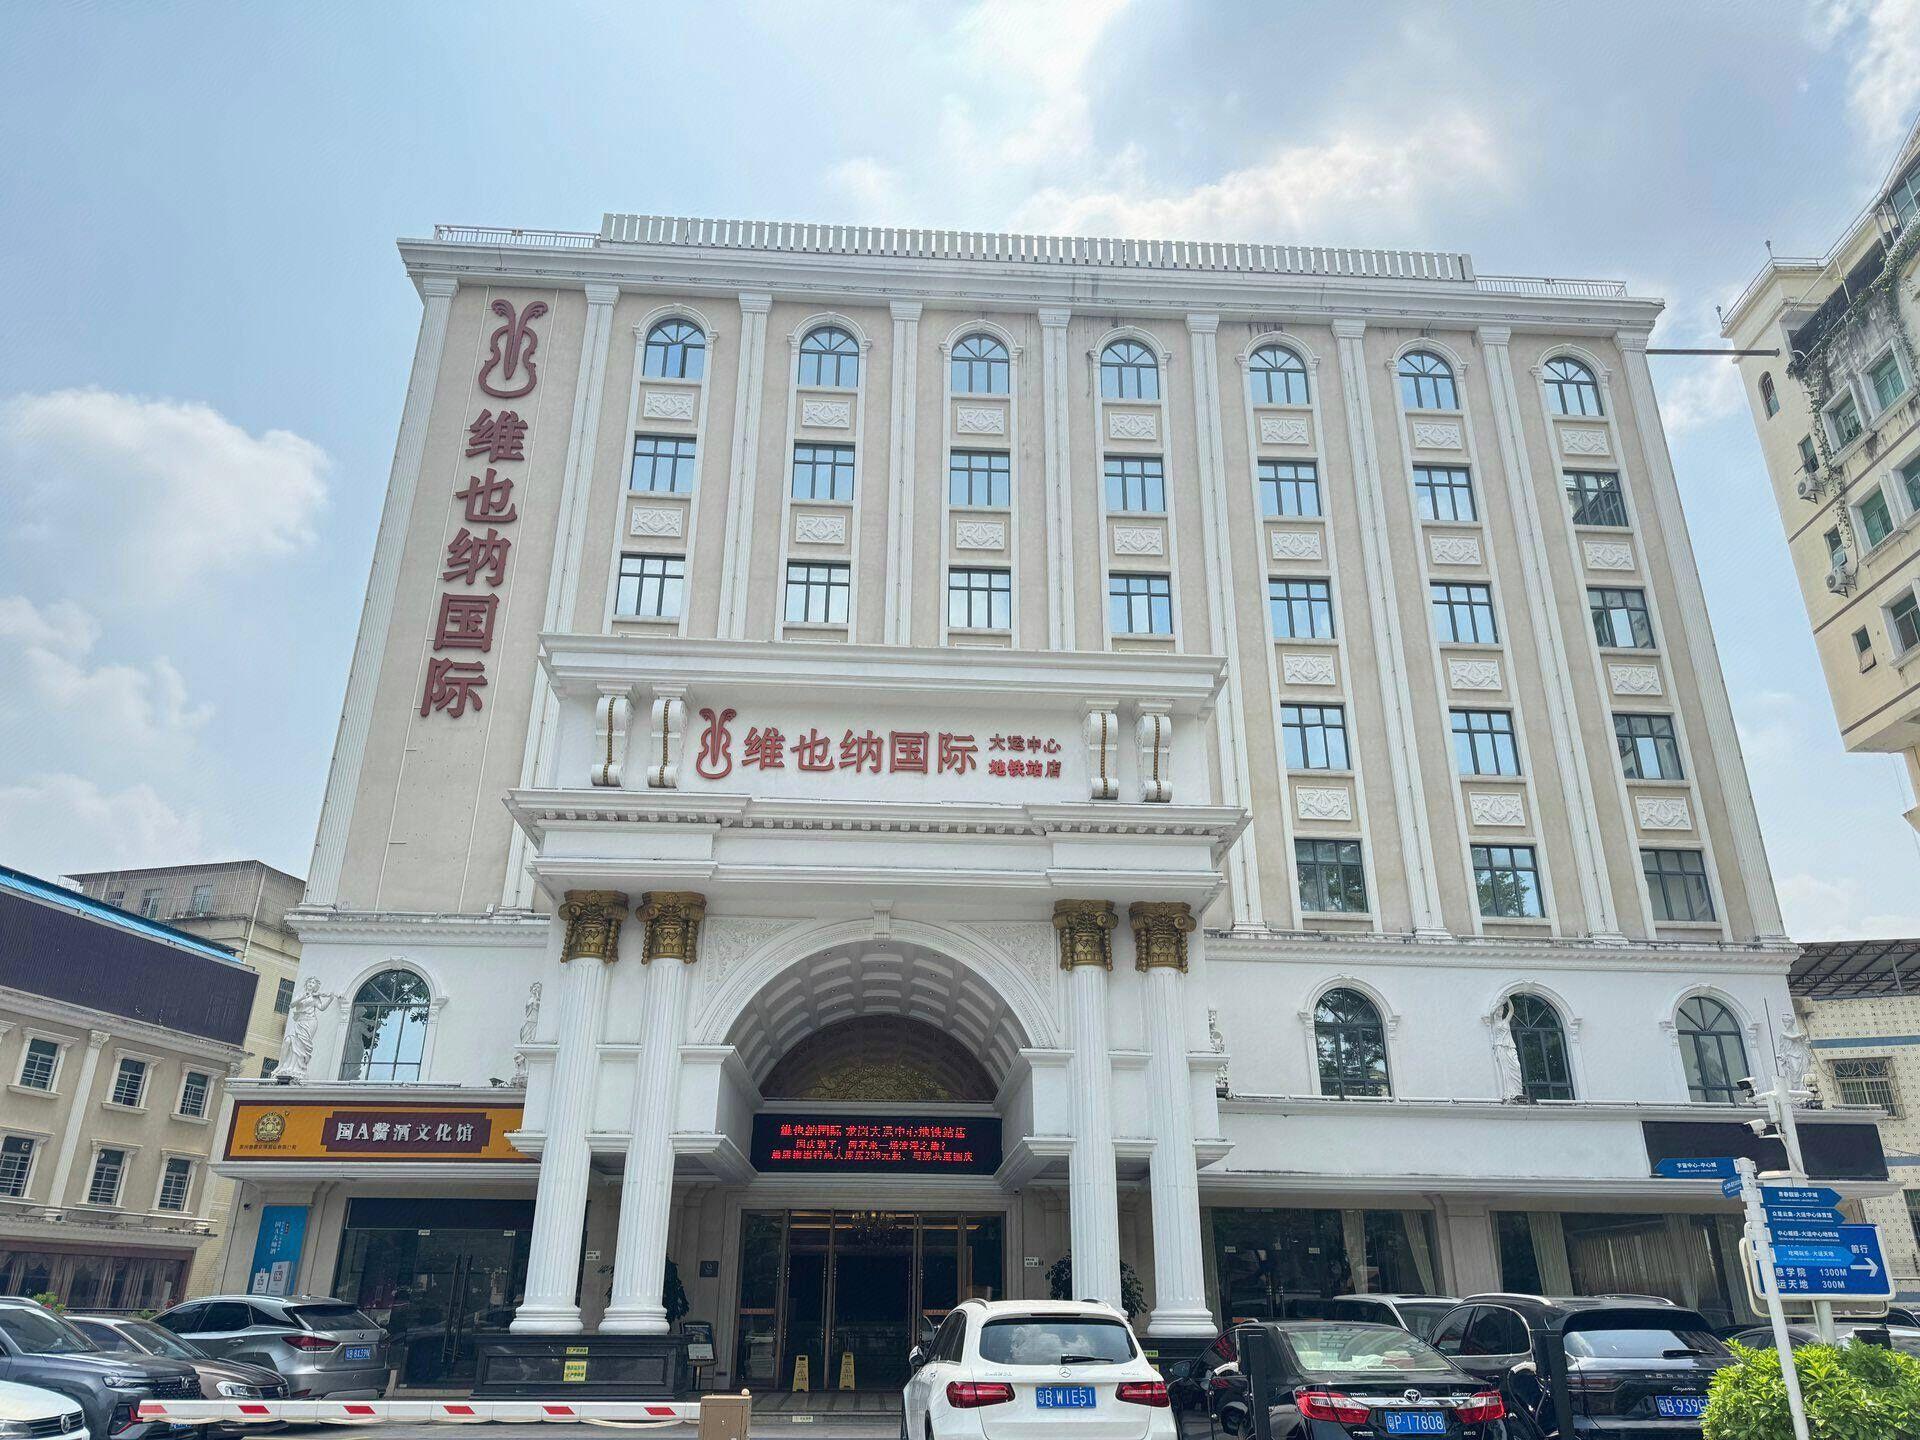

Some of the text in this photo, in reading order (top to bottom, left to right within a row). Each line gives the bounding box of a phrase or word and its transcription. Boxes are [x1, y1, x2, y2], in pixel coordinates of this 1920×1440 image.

[420, 408, 529, 718] 维也纳国际
[741, 727, 979, 775] 维也纳国际
[988, 733, 1062, 754] 大运中心
[988, 759, 1062, 778] 地铁站店
[1851, 1244, 1868, 1254] 前行
[1775, 1268, 1847, 1277] 息学院 1300M
[1776, 1280, 1845, 1289] 运天地 300M
